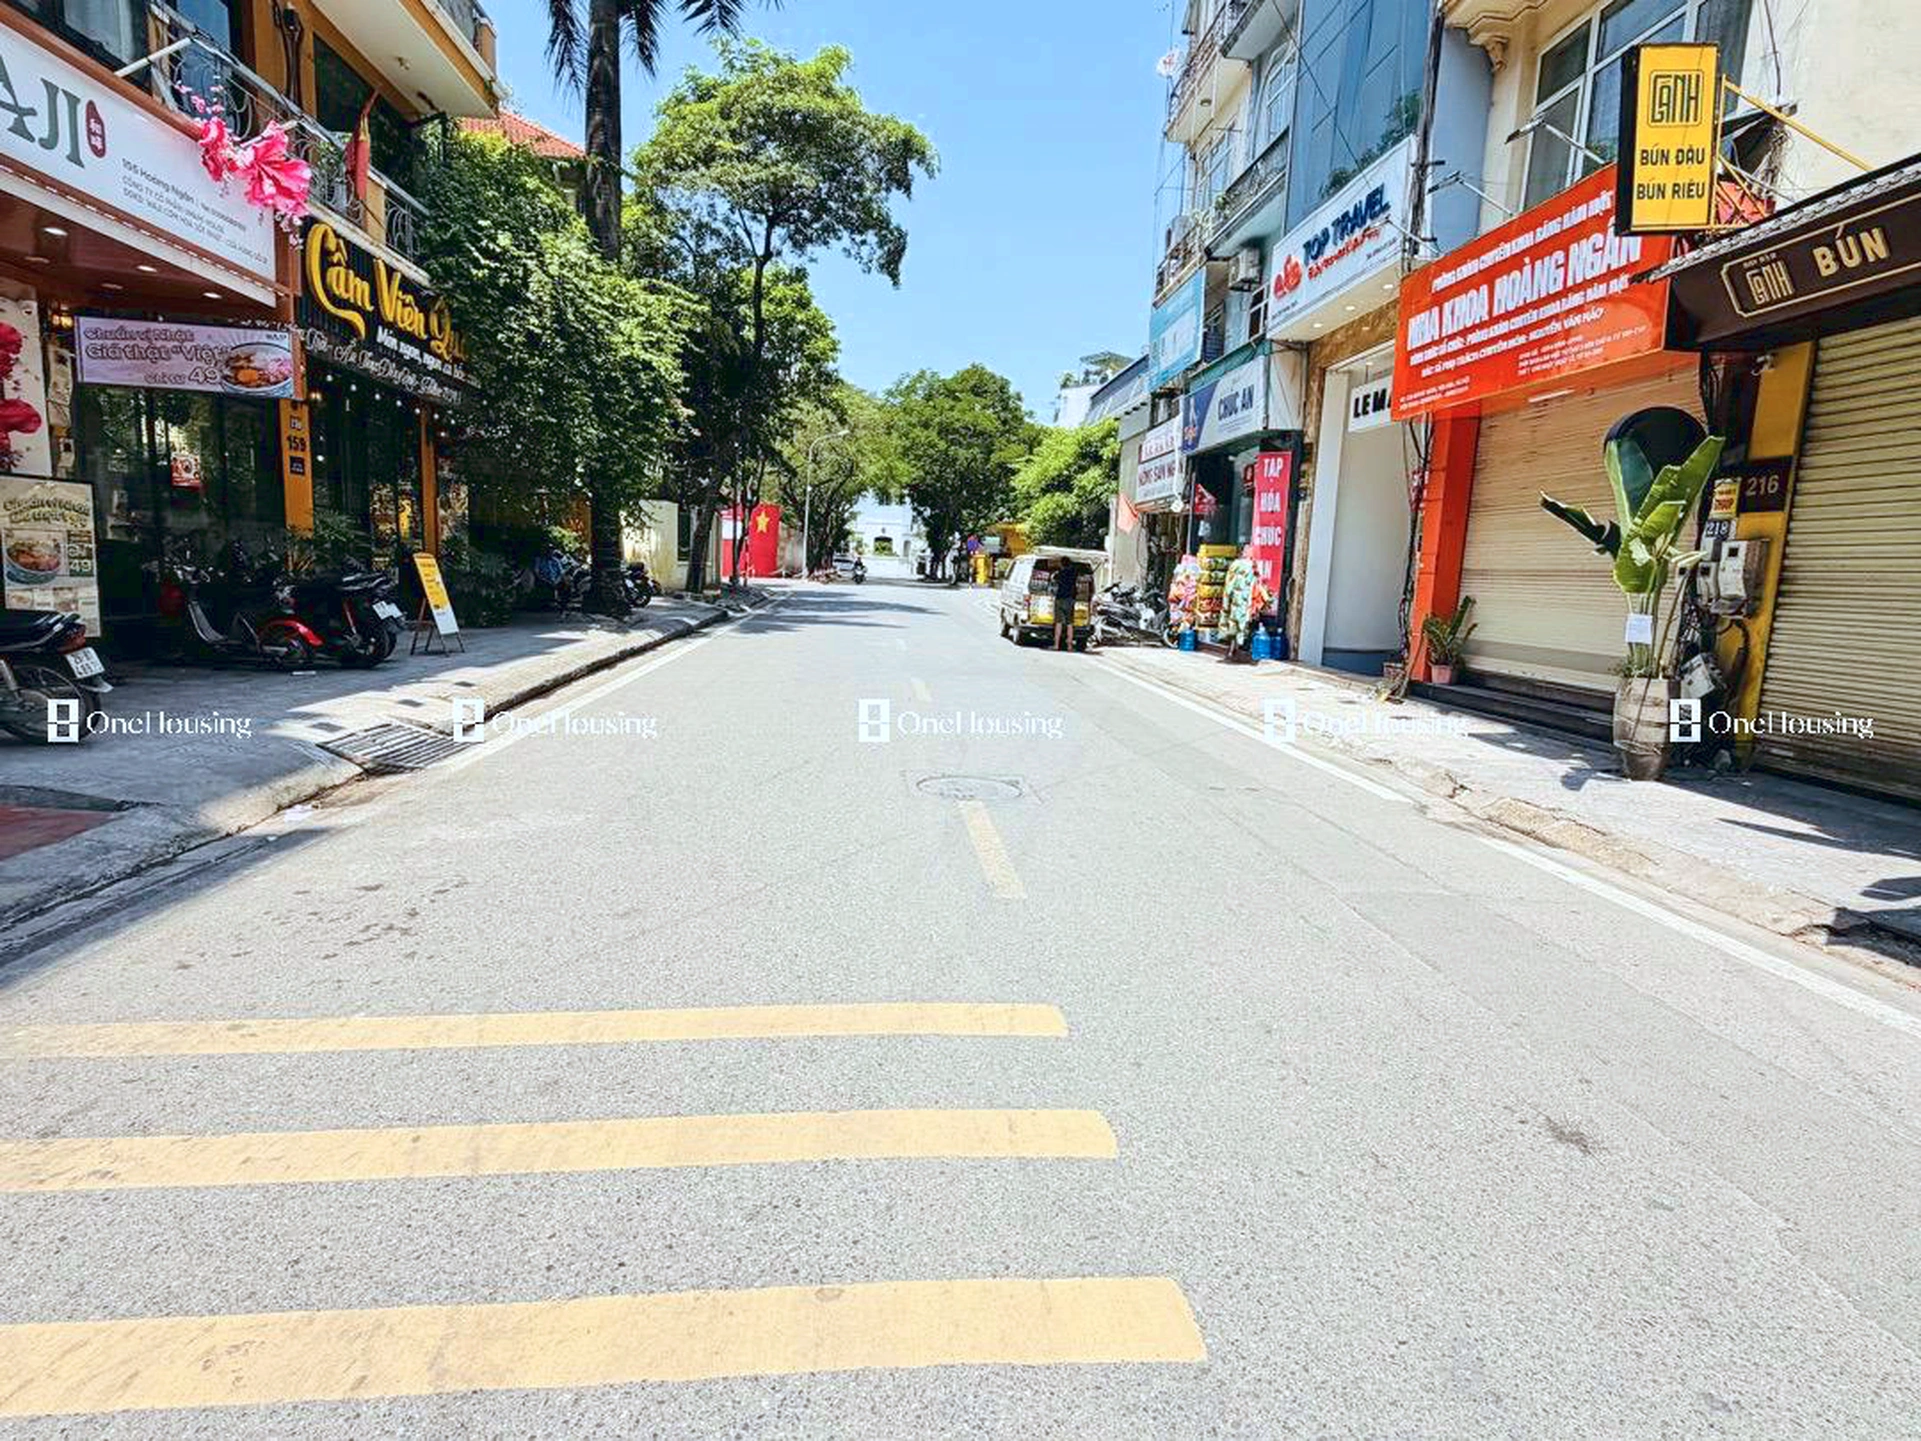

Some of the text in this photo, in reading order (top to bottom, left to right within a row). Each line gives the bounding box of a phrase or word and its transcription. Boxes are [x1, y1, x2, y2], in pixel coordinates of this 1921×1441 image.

[1640, 143, 1705, 169] BÚN ĐẬU
[1637, 177, 1705, 200] BÚN RIÊU
[1303, 226, 1331, 268] TOP
[1331, 182, 1392, 246] TRAVEL
[1812, 224, 1889, 277] BÚN
[373, 258, 429, 340] Viên
[1441, 284, 1489, 338] KHOA
[1492, 254, 1565, 317] HOÀNG
[1746, 475, 1779, 496] 216
[1706, 521, 1730, 535] 218
